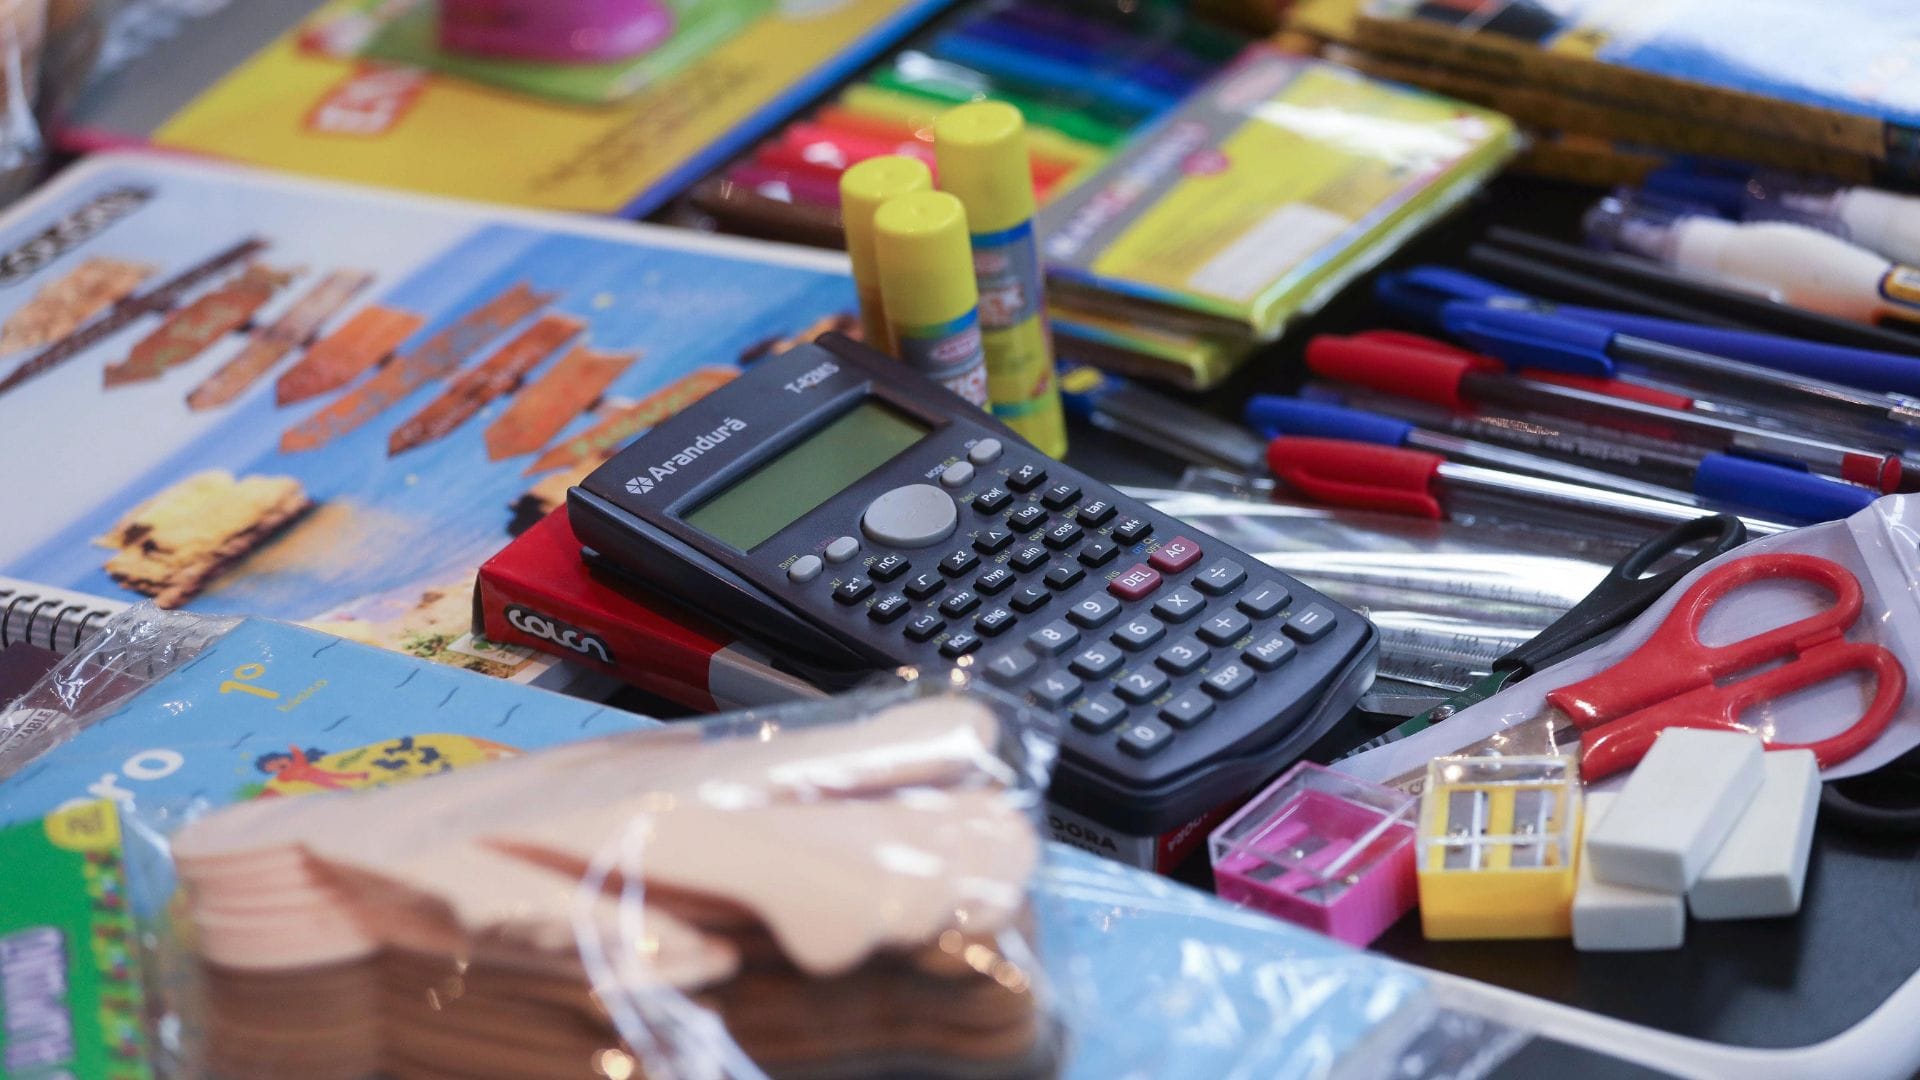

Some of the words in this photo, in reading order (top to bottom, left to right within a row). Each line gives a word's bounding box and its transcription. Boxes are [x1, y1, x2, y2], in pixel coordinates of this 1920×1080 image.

[1017, 506, 1039, 518] log
[1085, 500, 1106, 514] tan
[1053, 522, 1073, 536] cos
[1120, 519, 1141, 532] M+
[1022, 546, 1040, 559] sin
[1165, 543, 1186, 559] AC
[878, 554, 899, 569] nCr
[983, 568, 1005, 582] hyp
[1122, 570, 1152, 588] DEL
[1082, 600, 1102, 614] 9
[983, 608, 1008, 625] ENG
[1041, 627, 1061, 641] 8
[1128, 621, 1148, 635] 6
[1171, 645, 1193, 660] 3
[1255, 638, 1284, 657] Ans
[999, 654, 1017, 670] 7
[1083, 649, 1106, 665] 5
[1129, 673, 1153, 689] 2
[1211, 665, 1239, 686] EXP
[1045, 678, 1065, 691] 4
[1090, 701, 1110, 715] 1
[1133, 725, 1156, 741] 0
